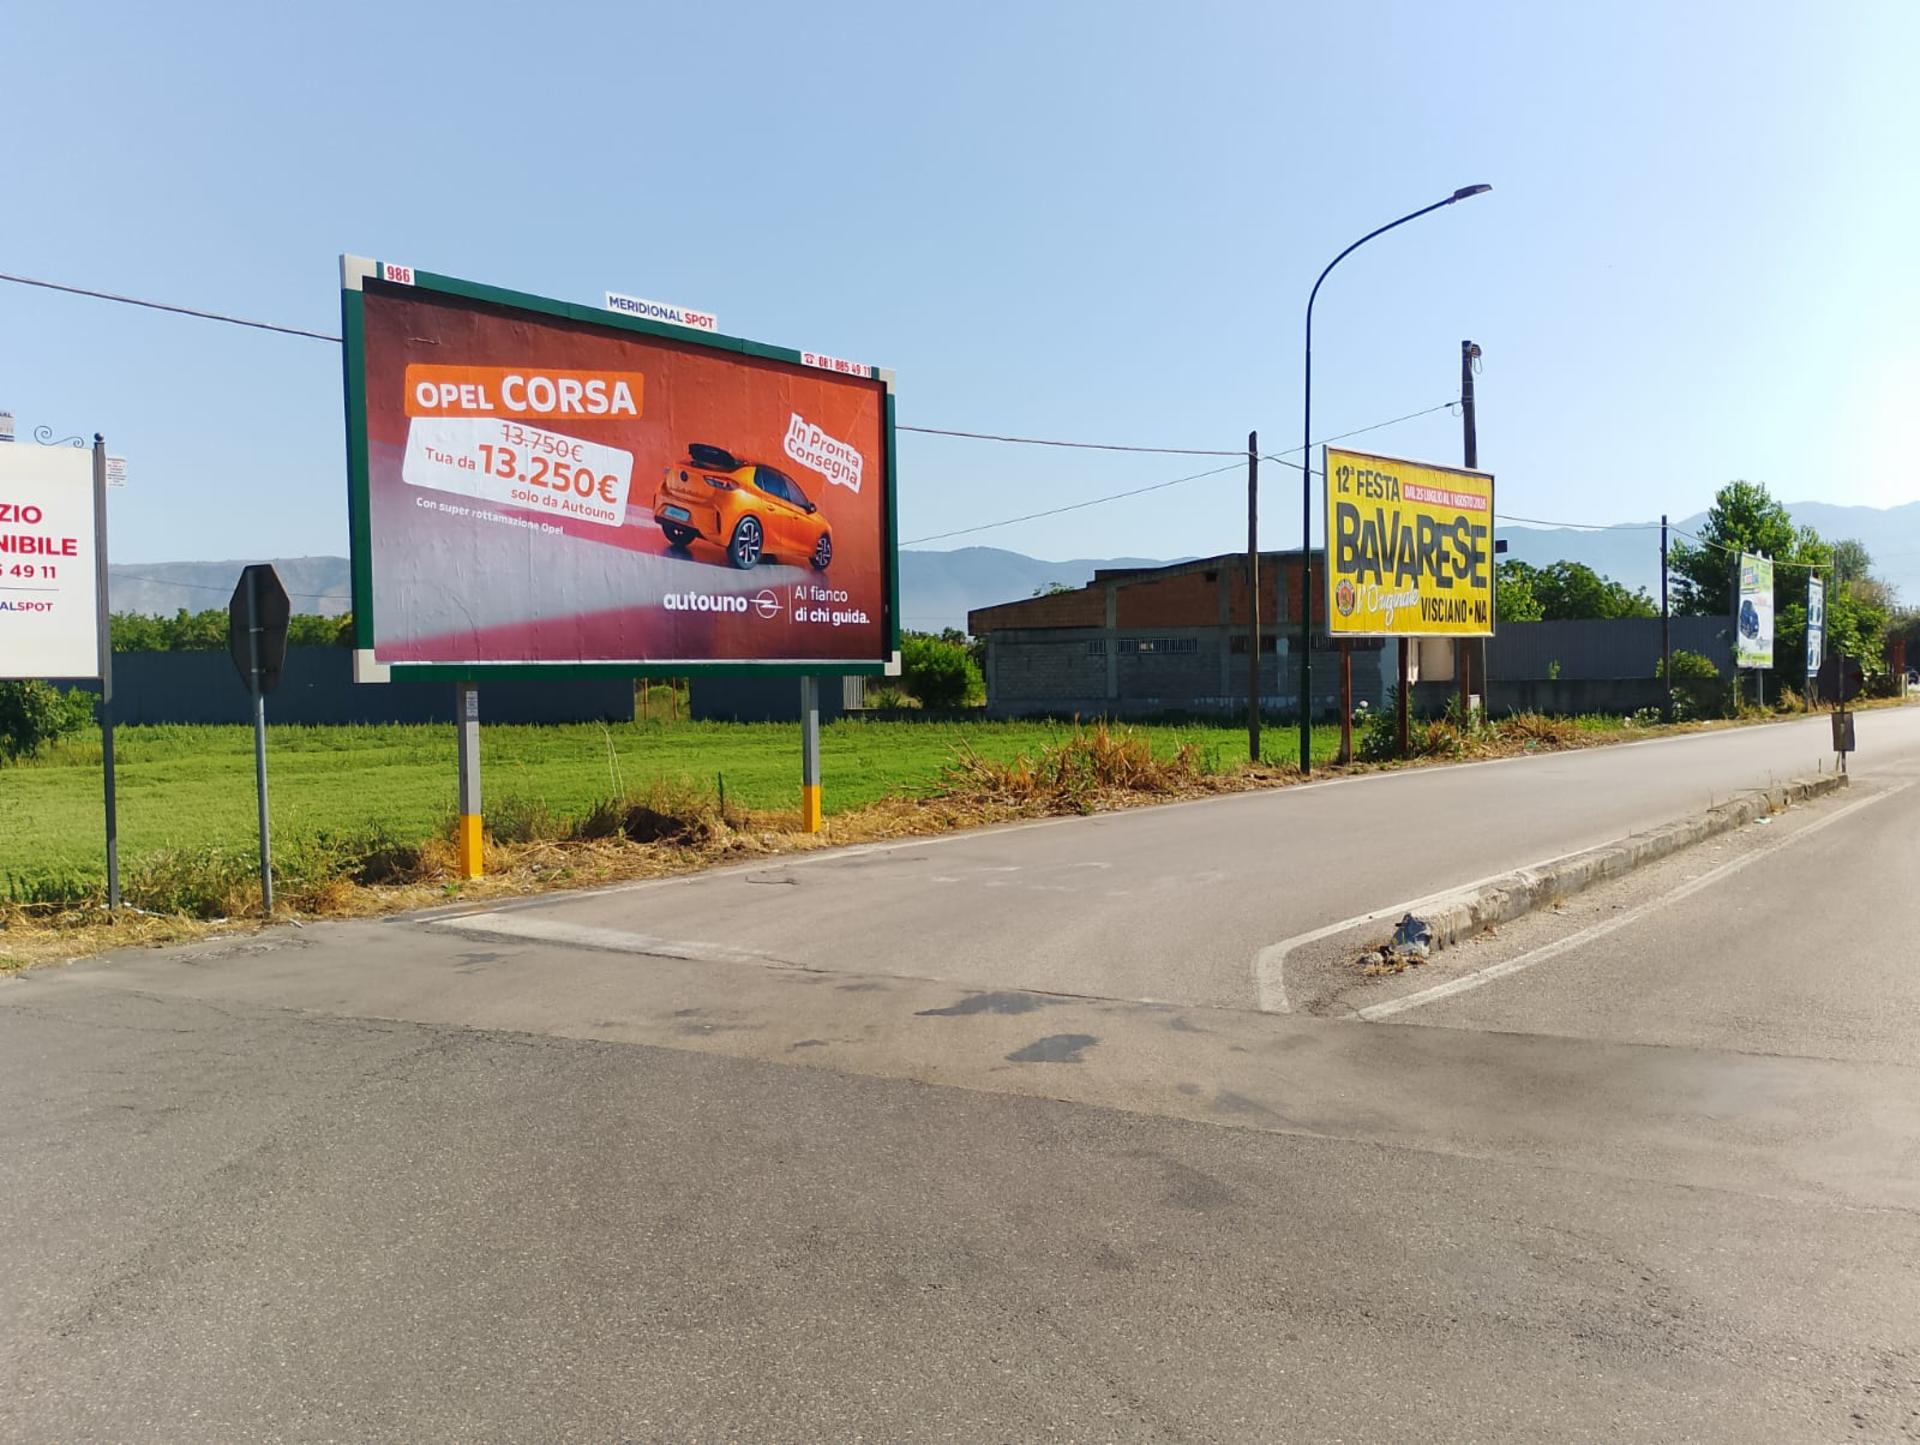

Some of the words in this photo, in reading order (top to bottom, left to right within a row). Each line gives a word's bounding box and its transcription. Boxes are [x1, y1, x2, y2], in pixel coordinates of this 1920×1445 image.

[387, 265, 410, 283] 986
[416, 382, 494, 410] OPEL
[502, 375, 638, 416] CORSA
[501, 424, 584, 462] 13.750€
[793, 420, 806, 443] In
[810, 430, 860, 469] Pronta
[425, 447, 453, 464] Tua
[457, 455, 476, 471] da
[478, 444, 619, 504] 13.250€
[788, 437, 858, 485] Consegna
[1357, 470, 1400, 502] FESTA
[416, 498, 437, 510] Con
[439, 502, 469, 516] super
[471, 510, 540, 531] rottamazione
[541, 522, 564, 535] Opel
[511, 487, 539, 501] solo
[542, 494, 558, 507] da
[562, 498, 616, 521] Autouno
[1336, 502, 1487, 588] BAVARESE
[10, 564, 34, 578] 49
[41, 566, 56, 579] 11
[663, 592, 748, 613] autouno
[795, 586, 807, 600] Al
[811, 588, 848, 603] fianco
[1421, 597, 1467, 623] VISCIANO
[1474, 600, 1487, 623] NA
[795, 608, 807, 622] di
[810, 609, 830, 622] chi
[832, 609, 870, 626] guida.
